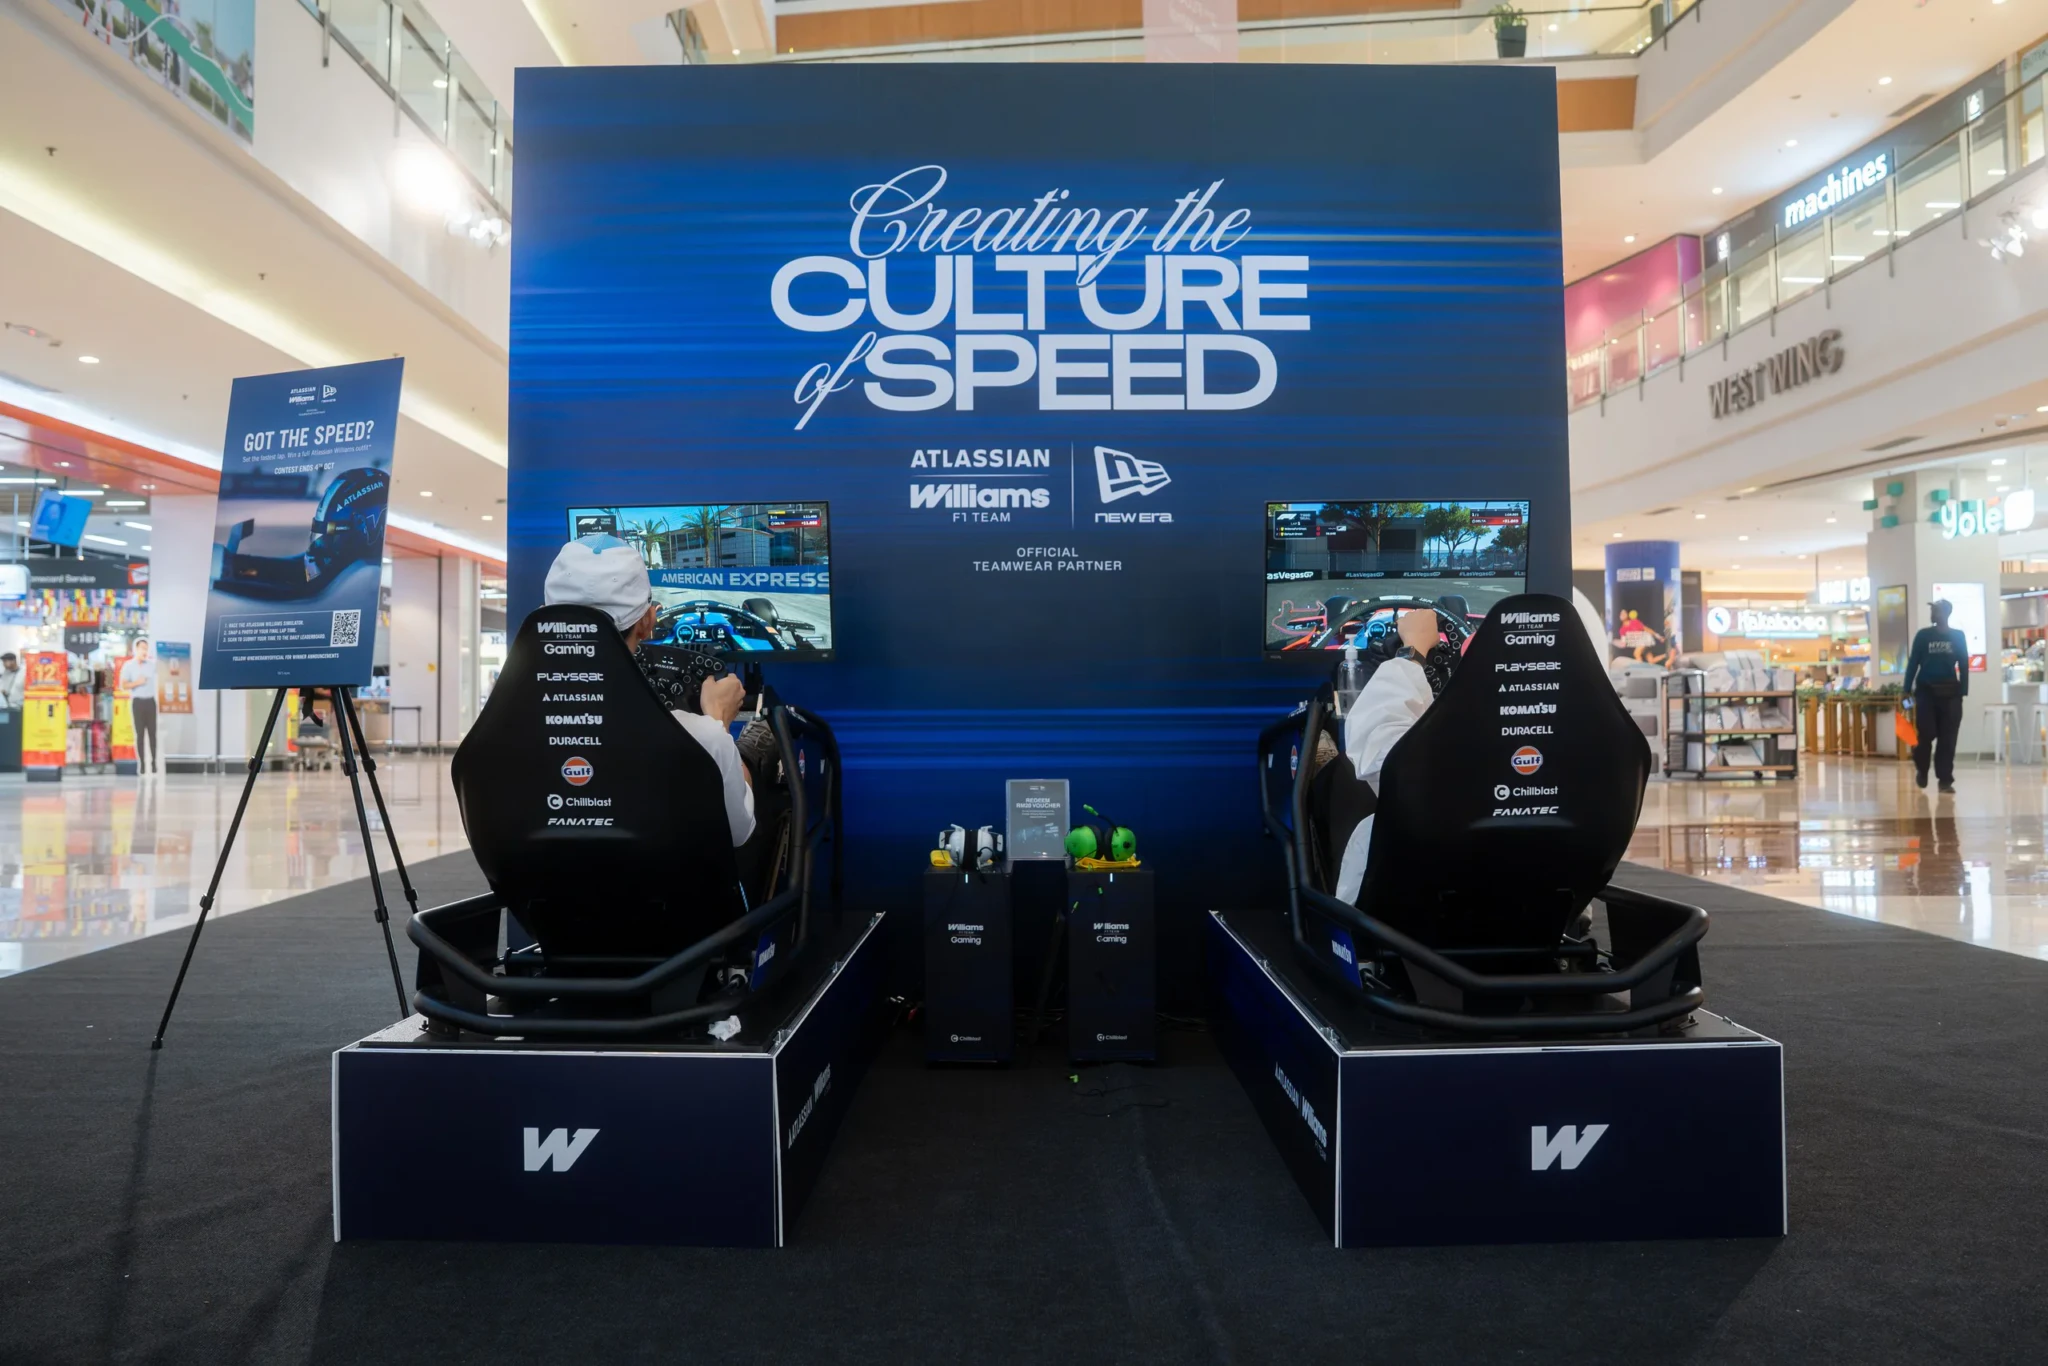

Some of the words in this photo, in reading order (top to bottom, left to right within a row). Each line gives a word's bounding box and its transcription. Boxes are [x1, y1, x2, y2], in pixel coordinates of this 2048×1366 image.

[1785, 153, 1888, 229] machines
[850, 165, 1148, 288] Creating
[1152, 178, 1252, 252] the
[770, 255, 1310, 331] CULTURE
[1708, 361, 1769, 419] WEST
[1767, 329, 1844, 395] WING
[794, 331, 877, 430] of
[864, 333, 1278, 411] SPEED
[290, 386, 316, 394] ATLASSIAN
[244, 431, 275, 452] GOT
[280, 427, 310, 449] THE
[314, 420, 375, 445] SPEED?
[334, 446, 355, 454] Williams
[910, 449, 1050, 468] ATLASSIAN
[274, 465, 299, 475] CONTEST
[300, 464, 314, 473] ENDS
[324, 462, 335, 470] OCT
[344, 481, 384, 506] ATLASSIAN
[910, 484, 1050, 509] Williams
[953, 513, 969, 522] F1
[972, 513, 1011, 522] TEAM
[1941, 496, 2003, 540] yolé
[1016, 548, 1078, 558] OFFICIAL
[973, 561, 1052, 571] TEAMWEAR
[1058, 561, 1122, 571] PARTNER
[661, 572, 723, 585] AMERICAN
[729, 572, 829, 588] EXPRESS
[1266, 571, 1314, 580] asVegasGP
[1501, 613, 1560, 624] Williams
[537, 622, 598, 633] Williams
[699, 630, 707, 639] R
[1505, 633, 1555, 646] Gaming
[544, 643, 595, 657] Gaming
[654, 663, 680, 671] FANATEC
[1509, 683, 1560, 692] ATLASSIAN
[1500, 703, 1557, 716] KOMATSU
[545, 713, 603, 725] KOMATSU
[1502, 726, 1553, 736] DURACELL
[549, 737, 602, 746] DURACELL
[1513, 756, 1540, 766] Gulf
[564, 767, 592, 777] Gulf
[1513, 786, 1558, 797] Chillblast
[566, 797, 612, 807] Chillblast
[1493, 806, 1559, 816] FANATEC
[548, 818, 614, 826] FANATEC
[951, 936, 981, 945] Gaming
[1096, 935, 1127, 944] Gaming
[1331, 939, 1352, 964] KOMATSU
[1279, 1067, 1299, 1110] ATLASSIAN
[1302, 1096, 1327, 1148] Williams
[792, 1096, 813, 1143] ATLASSIAN
